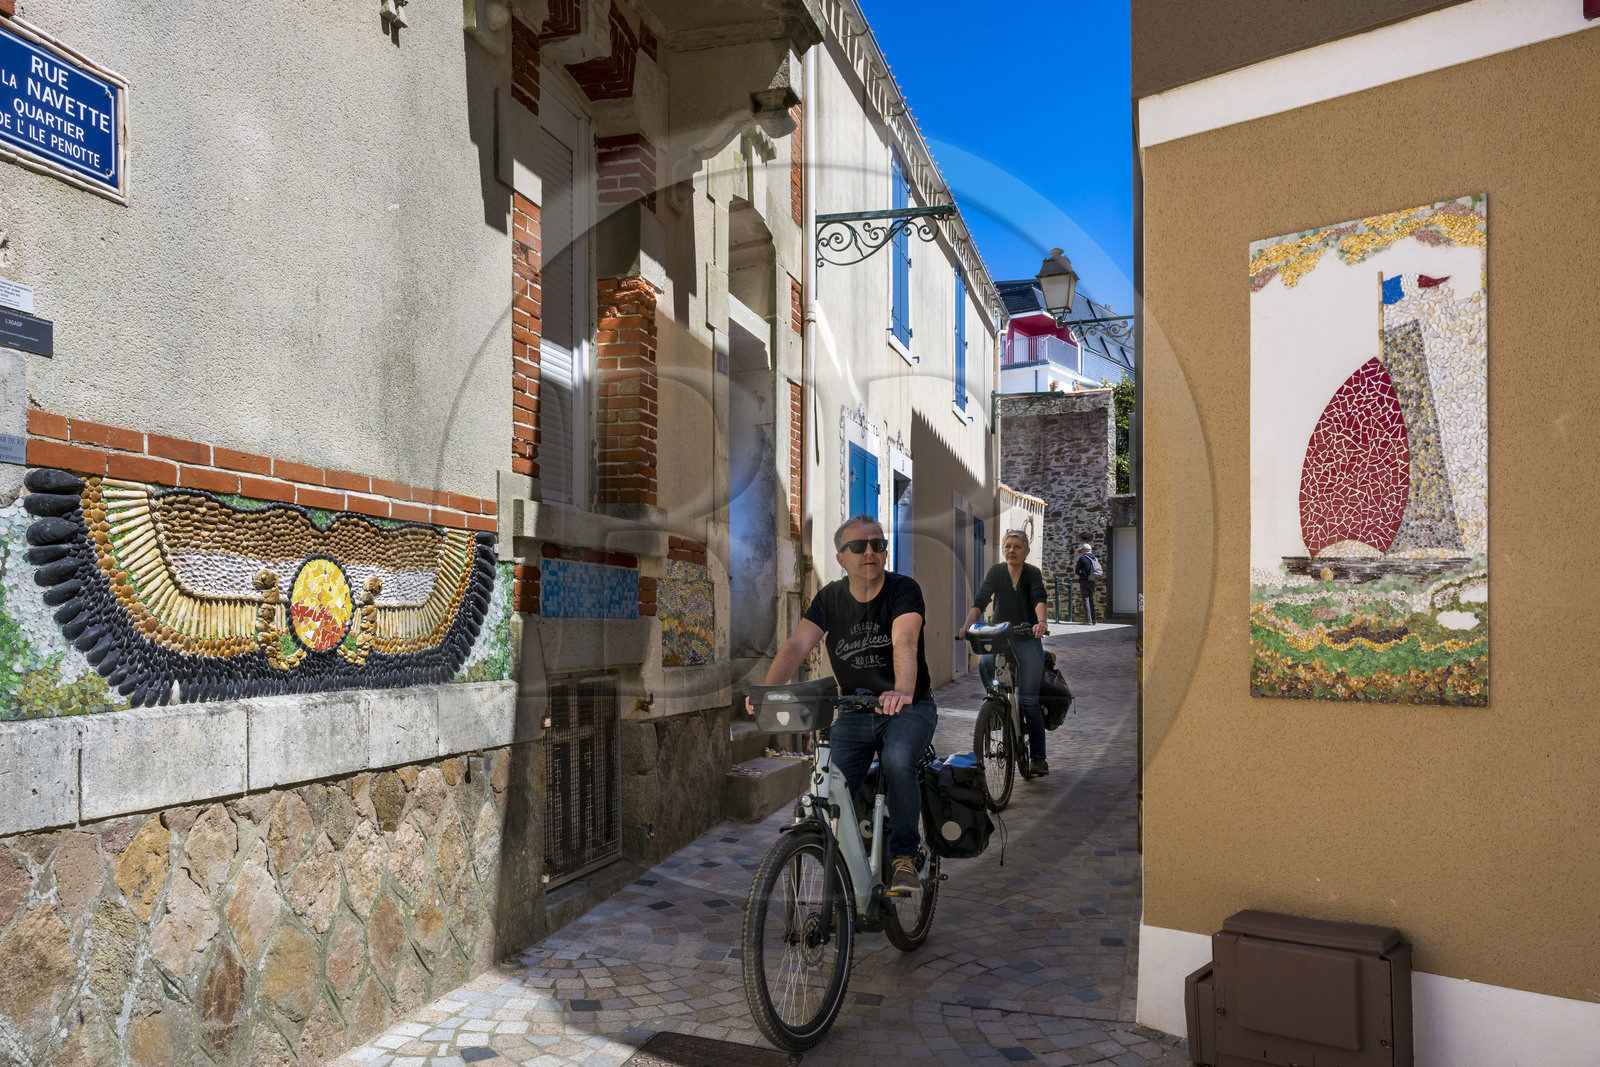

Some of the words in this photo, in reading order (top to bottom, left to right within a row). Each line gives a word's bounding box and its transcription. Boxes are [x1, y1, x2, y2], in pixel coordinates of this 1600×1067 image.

[31, 55, 69, 91] RUE
[1, 69, 17, 89] LA
[27, 76, 110, 134] NAVETTE
[13, 98, 85, 142] QUARTIER
[29, 124, 46, 144] ILE
[51, 133, 100, 168] PENOTTE
[834, 632, 892, 656] Complices
